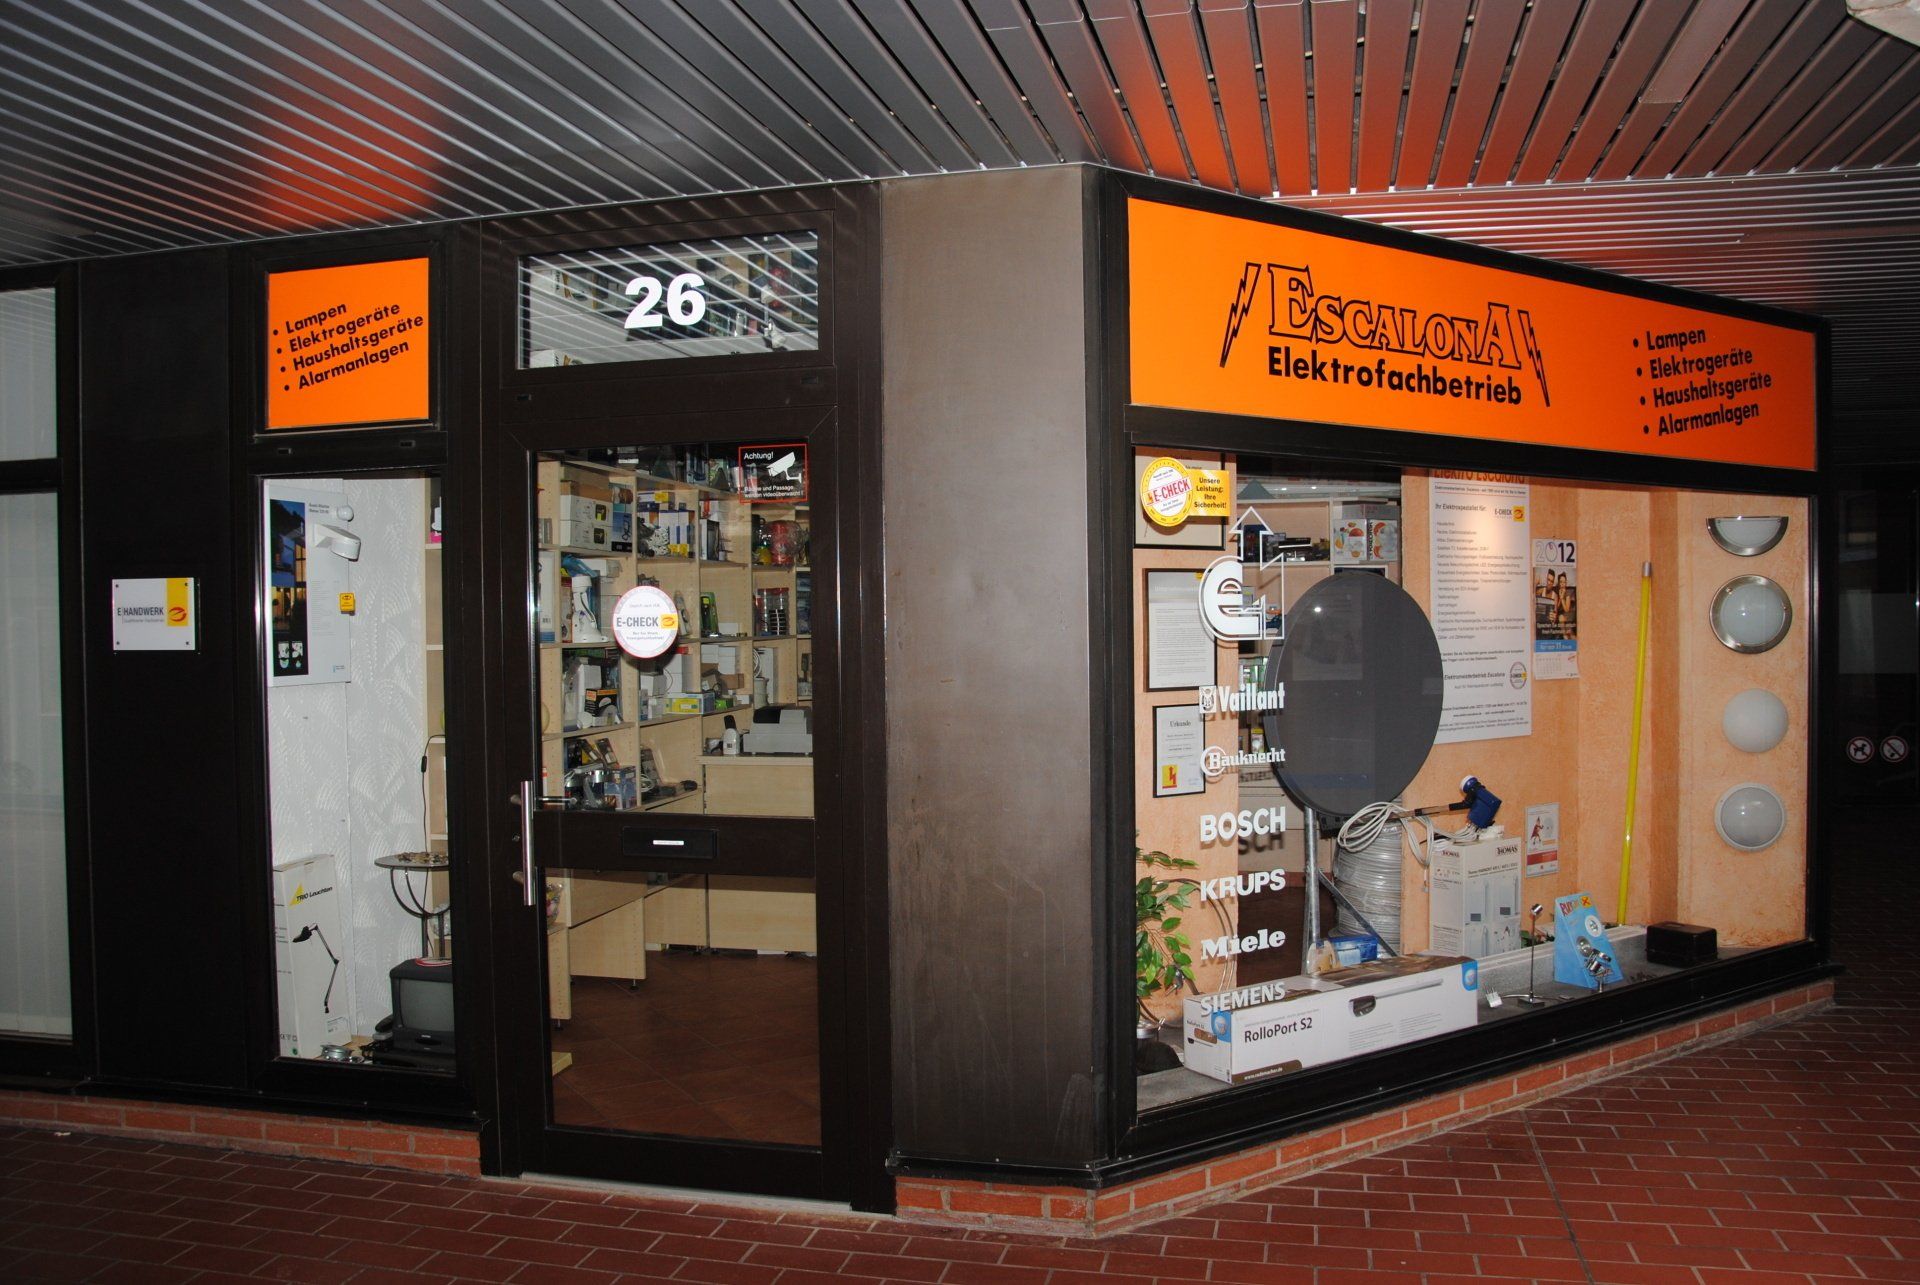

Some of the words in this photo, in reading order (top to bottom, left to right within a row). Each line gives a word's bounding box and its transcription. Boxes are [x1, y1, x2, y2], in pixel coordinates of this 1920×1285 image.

[624, 273, 706, 329] 26
[286, 303, 347, 334] Lampen
[289, 304, 400, 352] Elektrogeräte
[293, 316, 423, 371] Haushaltsgeräte
[1646, 329, 1706, 352] Lampen
[299, 341, 409, 389] Alarmanlagen
[1268, 345, 1522, 405] Elektrofachbetrieb
[1650, 348, 1753, 380] Elektrogeräte
[1653, 372, 1772, 408] Haushaltsgeräte
[1658, 403, 1760, 436] Alarmanlagen
[744, 451, 774, 460] Achtung!
[1153, 479, 1190, 502] E-CHECK
[1194, 501, 1227, 509] Sicherheit!
[124, 607, 164, 616] HANDWERK
[616, 617, 659, 627] E-CHECK
[1218, 682, 1285, 712] Vaillant
[1208, 748, 1286, 770] Bauknecht
[1200, 806, 1286, 842] BOSCH
[1200, 868, 1286, 901] KRUPS
[1200, 928, 1286, 960] Miele
[1200, 981, 1286, 1017] SIEMENS
[1244, 1020, 1298, 1043] RolloPort
[1300, 1017, 1313, 1030] S2
